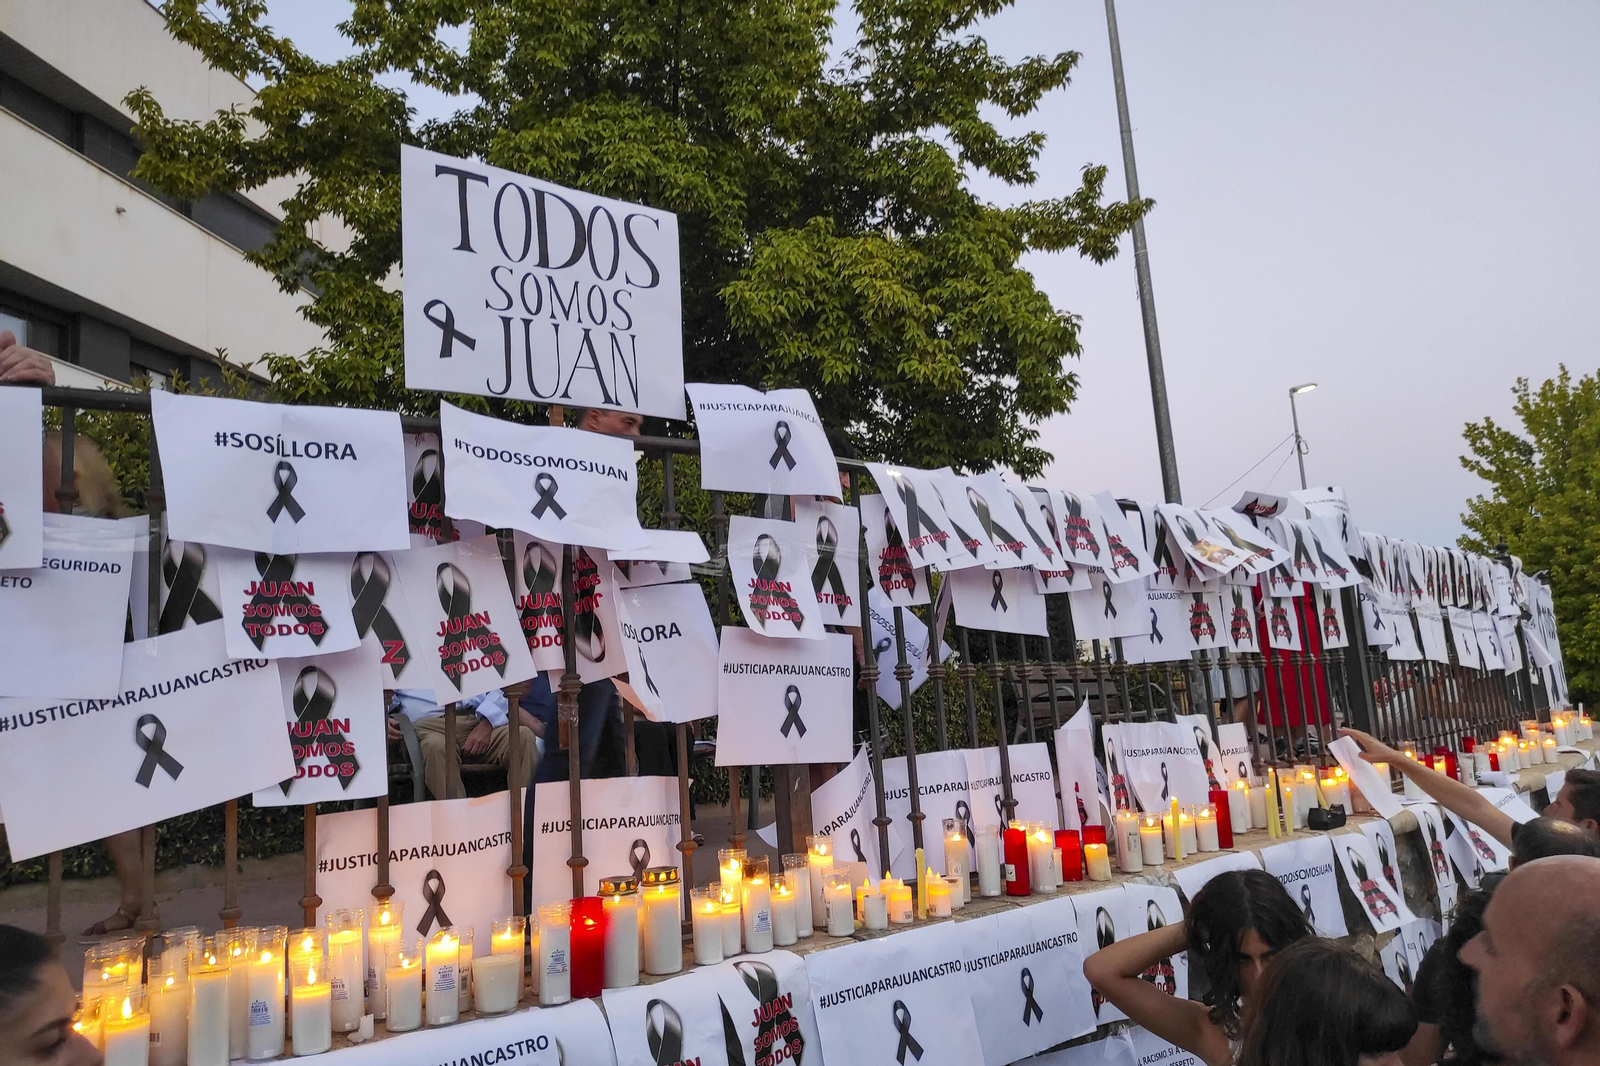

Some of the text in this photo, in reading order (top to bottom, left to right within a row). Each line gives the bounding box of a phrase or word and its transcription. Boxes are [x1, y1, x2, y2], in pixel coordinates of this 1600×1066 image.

[435, 164, 660, 289] TODOS
[485, 265, 633, 331] SOMOS
[486, 315, 638, 408] JUAN
[214, 431, 358, 461] #SOSÍLLORA
[454, 437, 629, 482] #TODOSSOMOSJUAN
[411, 502, 442, 519] UA
[42, 557, 122, 575] EGURIDAD
[0, 576, 33, 589] ETO
[243, 581, 315, 597] JUAN
[748, 578, 792, 593] JUAN
[748, 593, 799, 608] SOMOS
[817, 591, 853, 606] STICIA
[242, 602, 322, 618] SOMOS
[754, 608, 802, 622] TODOS
[245, 621, 325, 637] TODOS
[437, 610, 492, 637] JUAN
[438, 631, 501, 659] SOMOS
[444, 650, 505, 676] TODOS
[723, 663, 850, 678] #JUSTICIAPARAJUANCASTRO
[0, 658, 270, 732] #JUSTICIAPARAJUANCASTRO
[292, 740, 355, 759] OMOS
[294, 761, 354, 780] ODOS
[541, 813, 682, 835] #JUSICIAPARAJUANCASTR
[318, 831, 513, 873] #JUSTICAPARAJUANCASTR
[819, 959, 962, 1010] #JUSTICIAPARAJUANCASTRO
[751, 992, 793, 1029] JUAN
[753, 1015, 799, 1053] SOMOS
